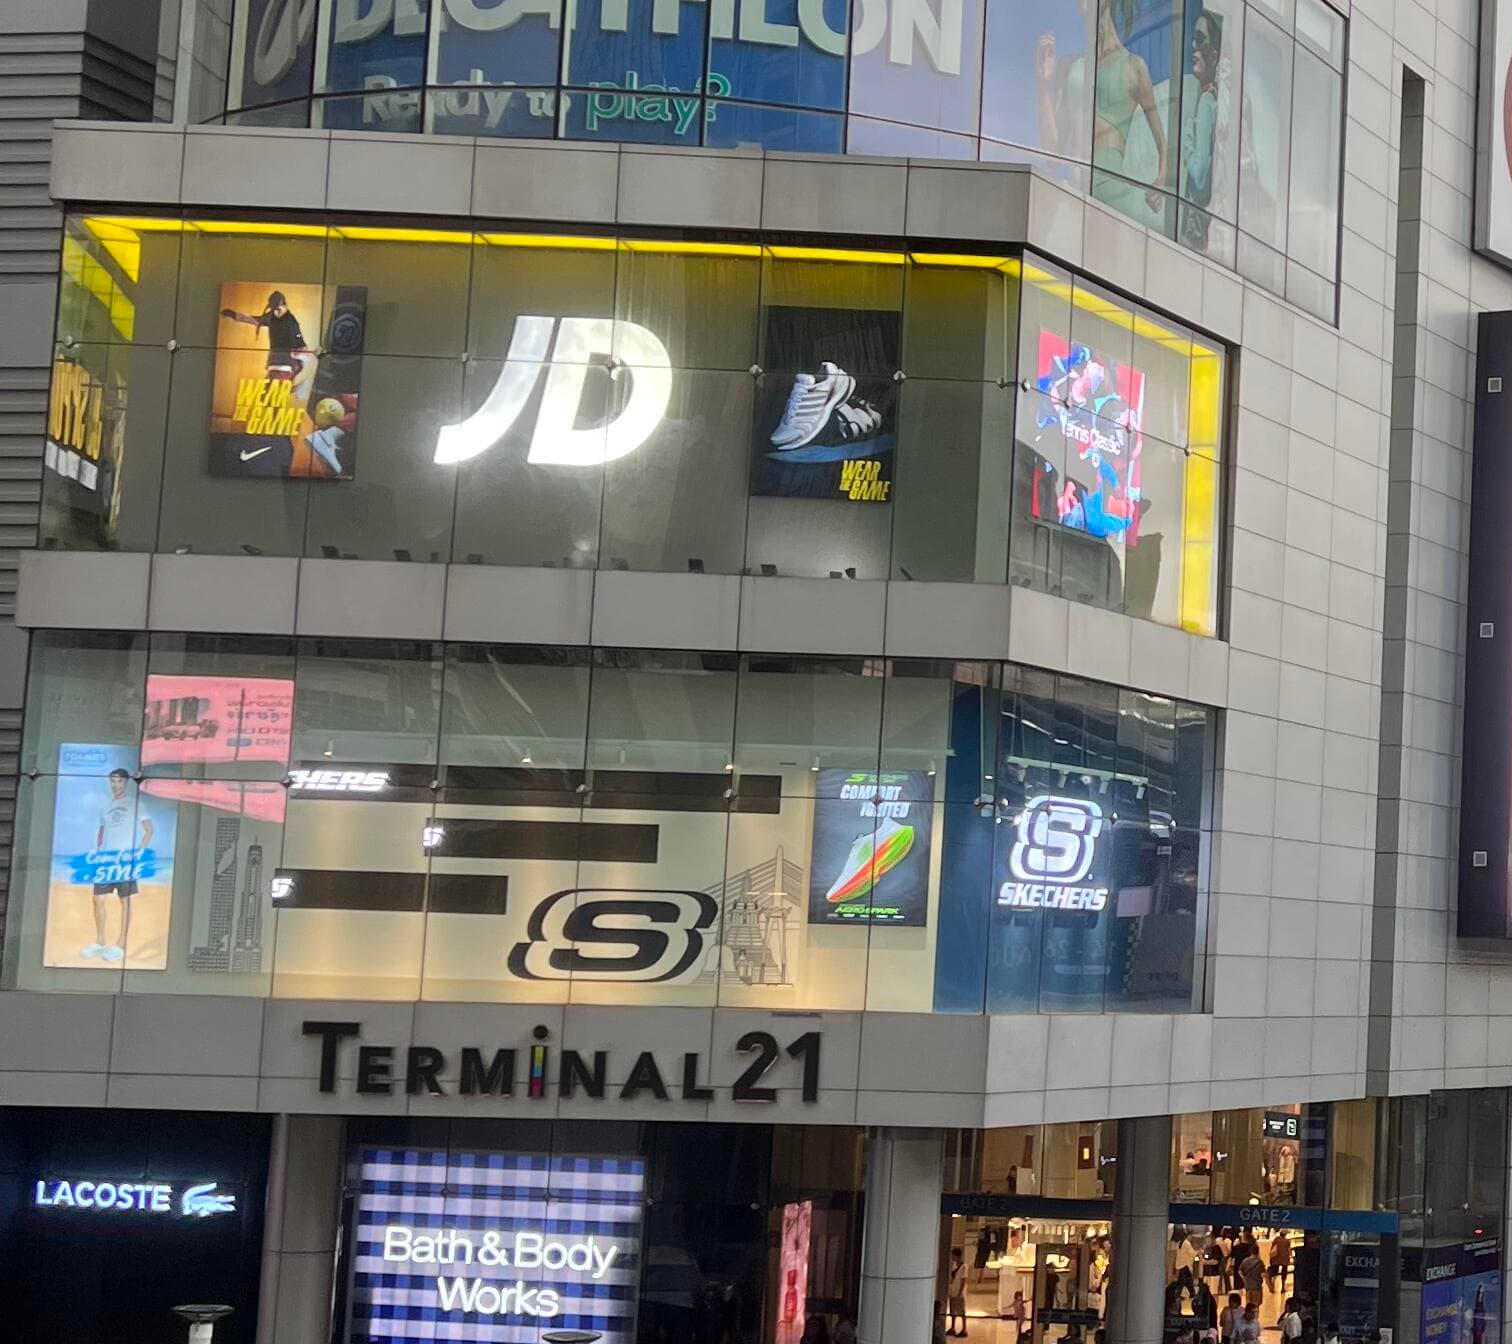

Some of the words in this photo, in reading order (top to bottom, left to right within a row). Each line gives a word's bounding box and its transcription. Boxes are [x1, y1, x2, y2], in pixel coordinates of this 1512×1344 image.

[363, 69, 514, 129] Ready
[528, 87, 571, 117] to
[586, 70, 732, 136] play?
[236, 378, 293, 408] WEAR
[433, 315, 673, 466] JD
[246, 408, 306, 436] GAME
[841, 459, 881, 481] WEAR
[849, 480, 891, 501] GAME
[997, 882, 1109, 911] SKECHERS
[732, 1030, 824, 1103] 21
[35, 1180, 171, 1211] LACOSTE
[1239, 1207, 1279, 1223] GATE
[1280, 1210, 1291, 1224] 2
[383, 1225, 474, 1265] Bath
[477, 1232, 510, 1267] &
[514, 1235, 619, 1278] Body
[1425, 1262, 1457, 1282] EXCHANGE
[437, 1275, 560, 1318] Works
